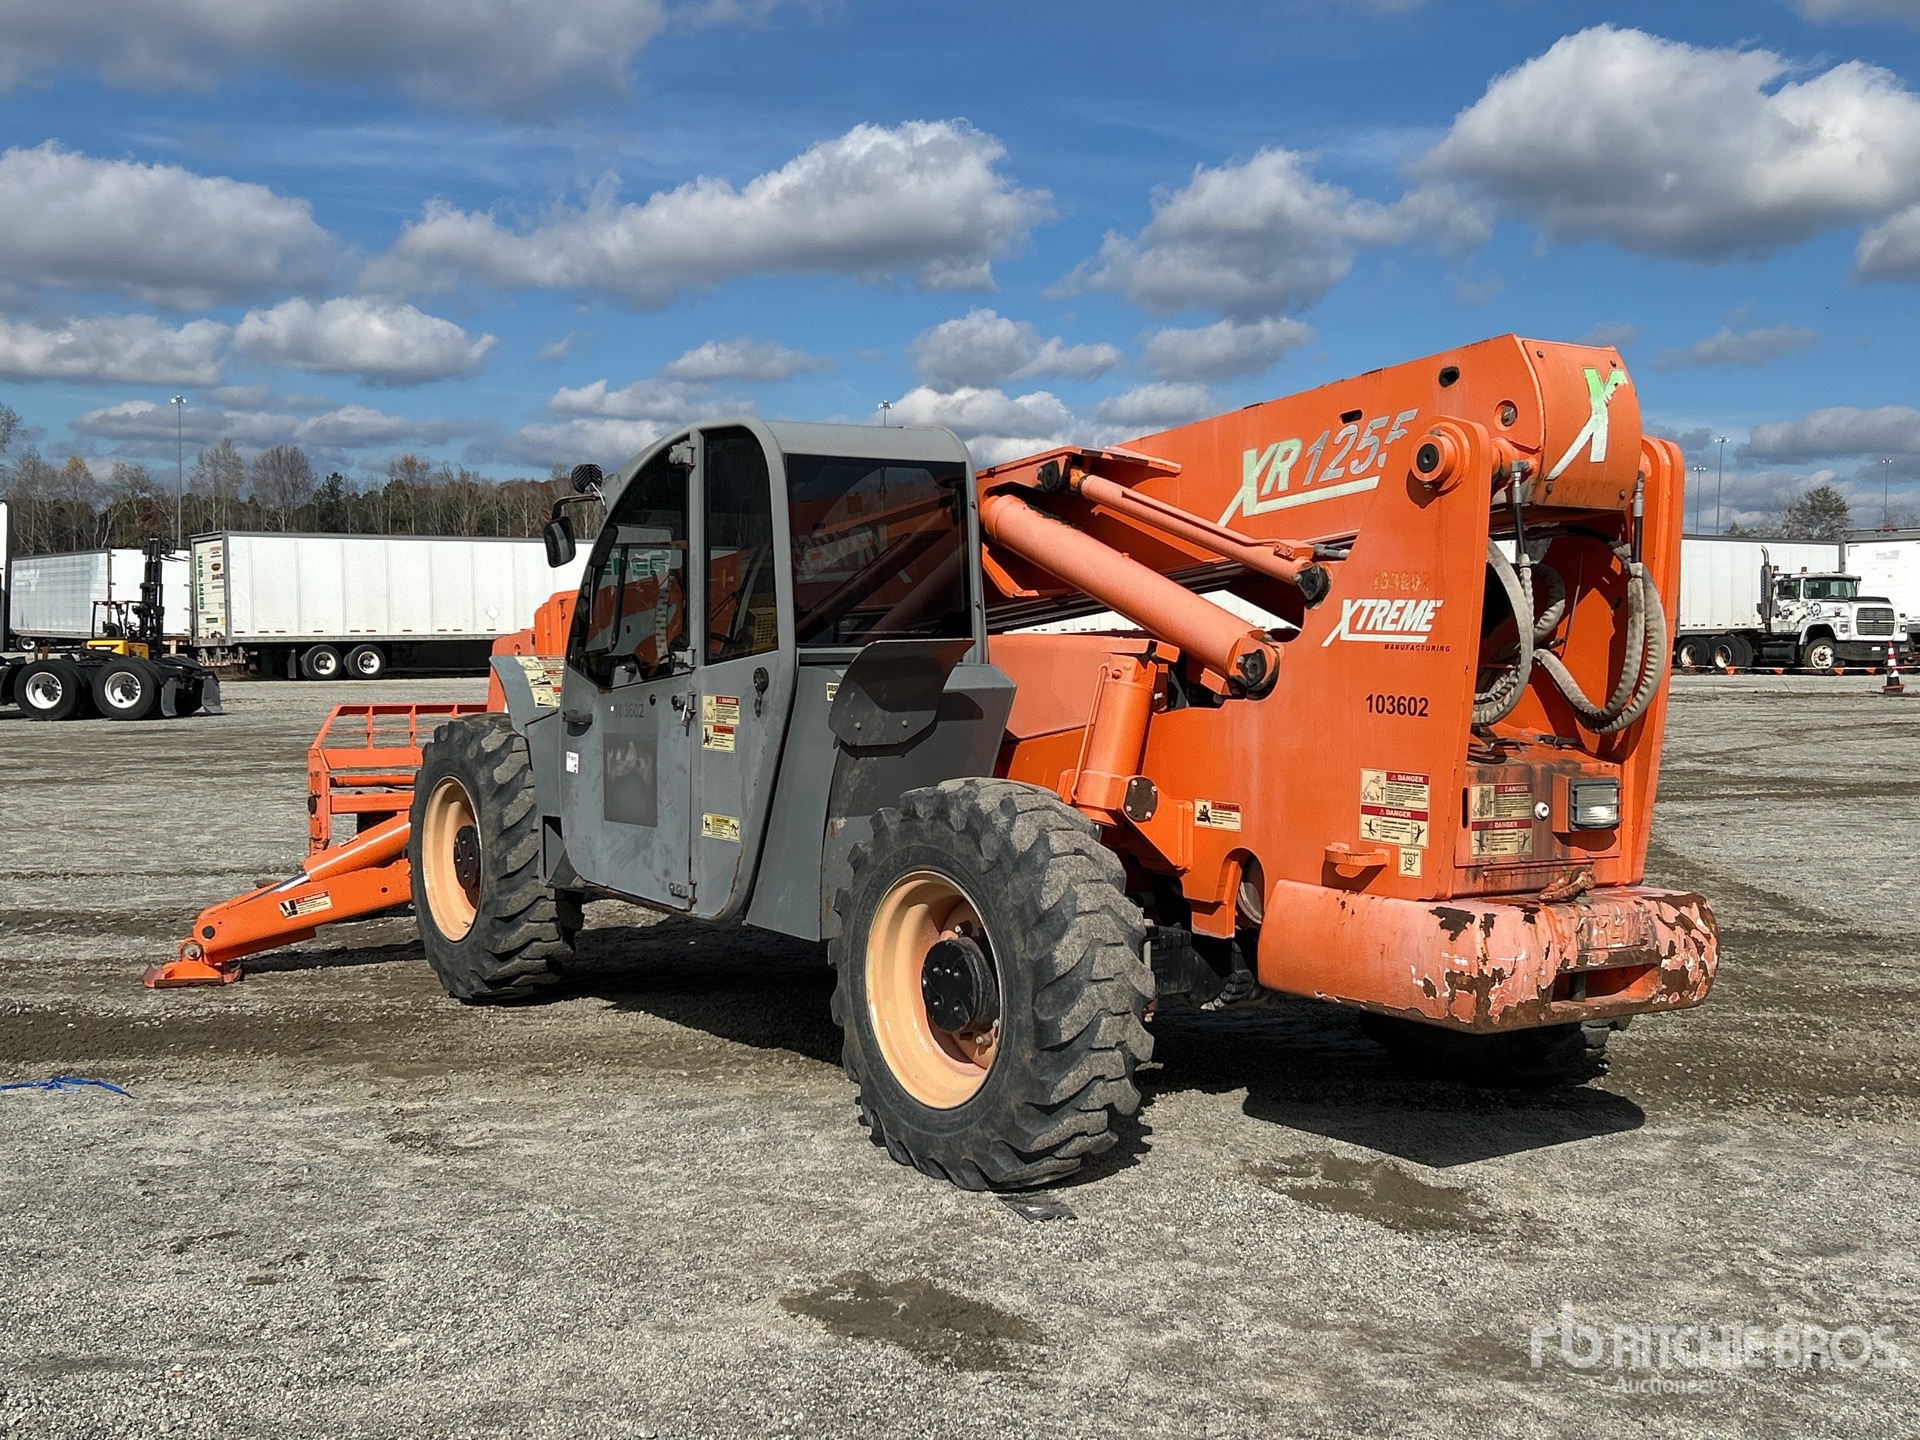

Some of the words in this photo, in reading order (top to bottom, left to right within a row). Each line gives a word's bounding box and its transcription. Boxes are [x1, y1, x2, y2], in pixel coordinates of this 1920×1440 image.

[1321, 598, 1444, 648] XTREME
[1384, 643, 1451, 653] MANUFACTURING
[1365, 693, 1429, 718] 103602
[1397, 774, 1424, 783] DANGER
[1504, 785, 1529, 793] DANGER
[1385, 809, 1412, 819] DANGER
[1494, 821, 1518, 829] DANGER
